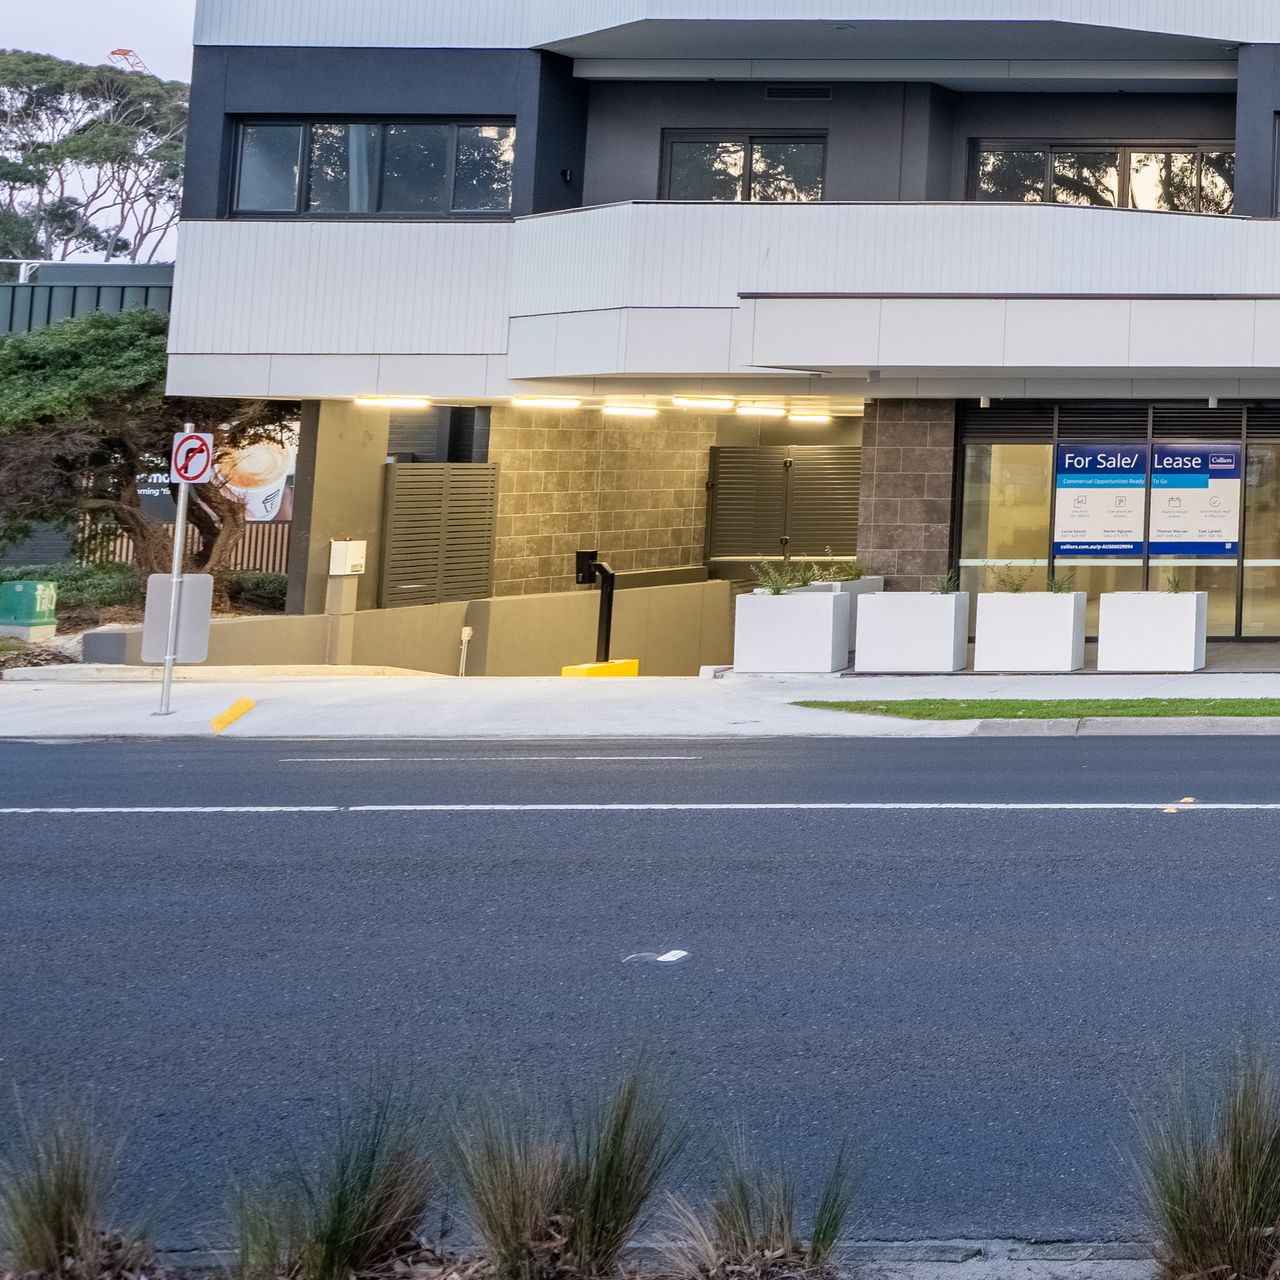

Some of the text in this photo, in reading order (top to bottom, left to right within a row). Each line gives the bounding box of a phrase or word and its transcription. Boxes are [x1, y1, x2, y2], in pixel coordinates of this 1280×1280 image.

[1065, 453, 1202, 468] For Sale/ Lease
